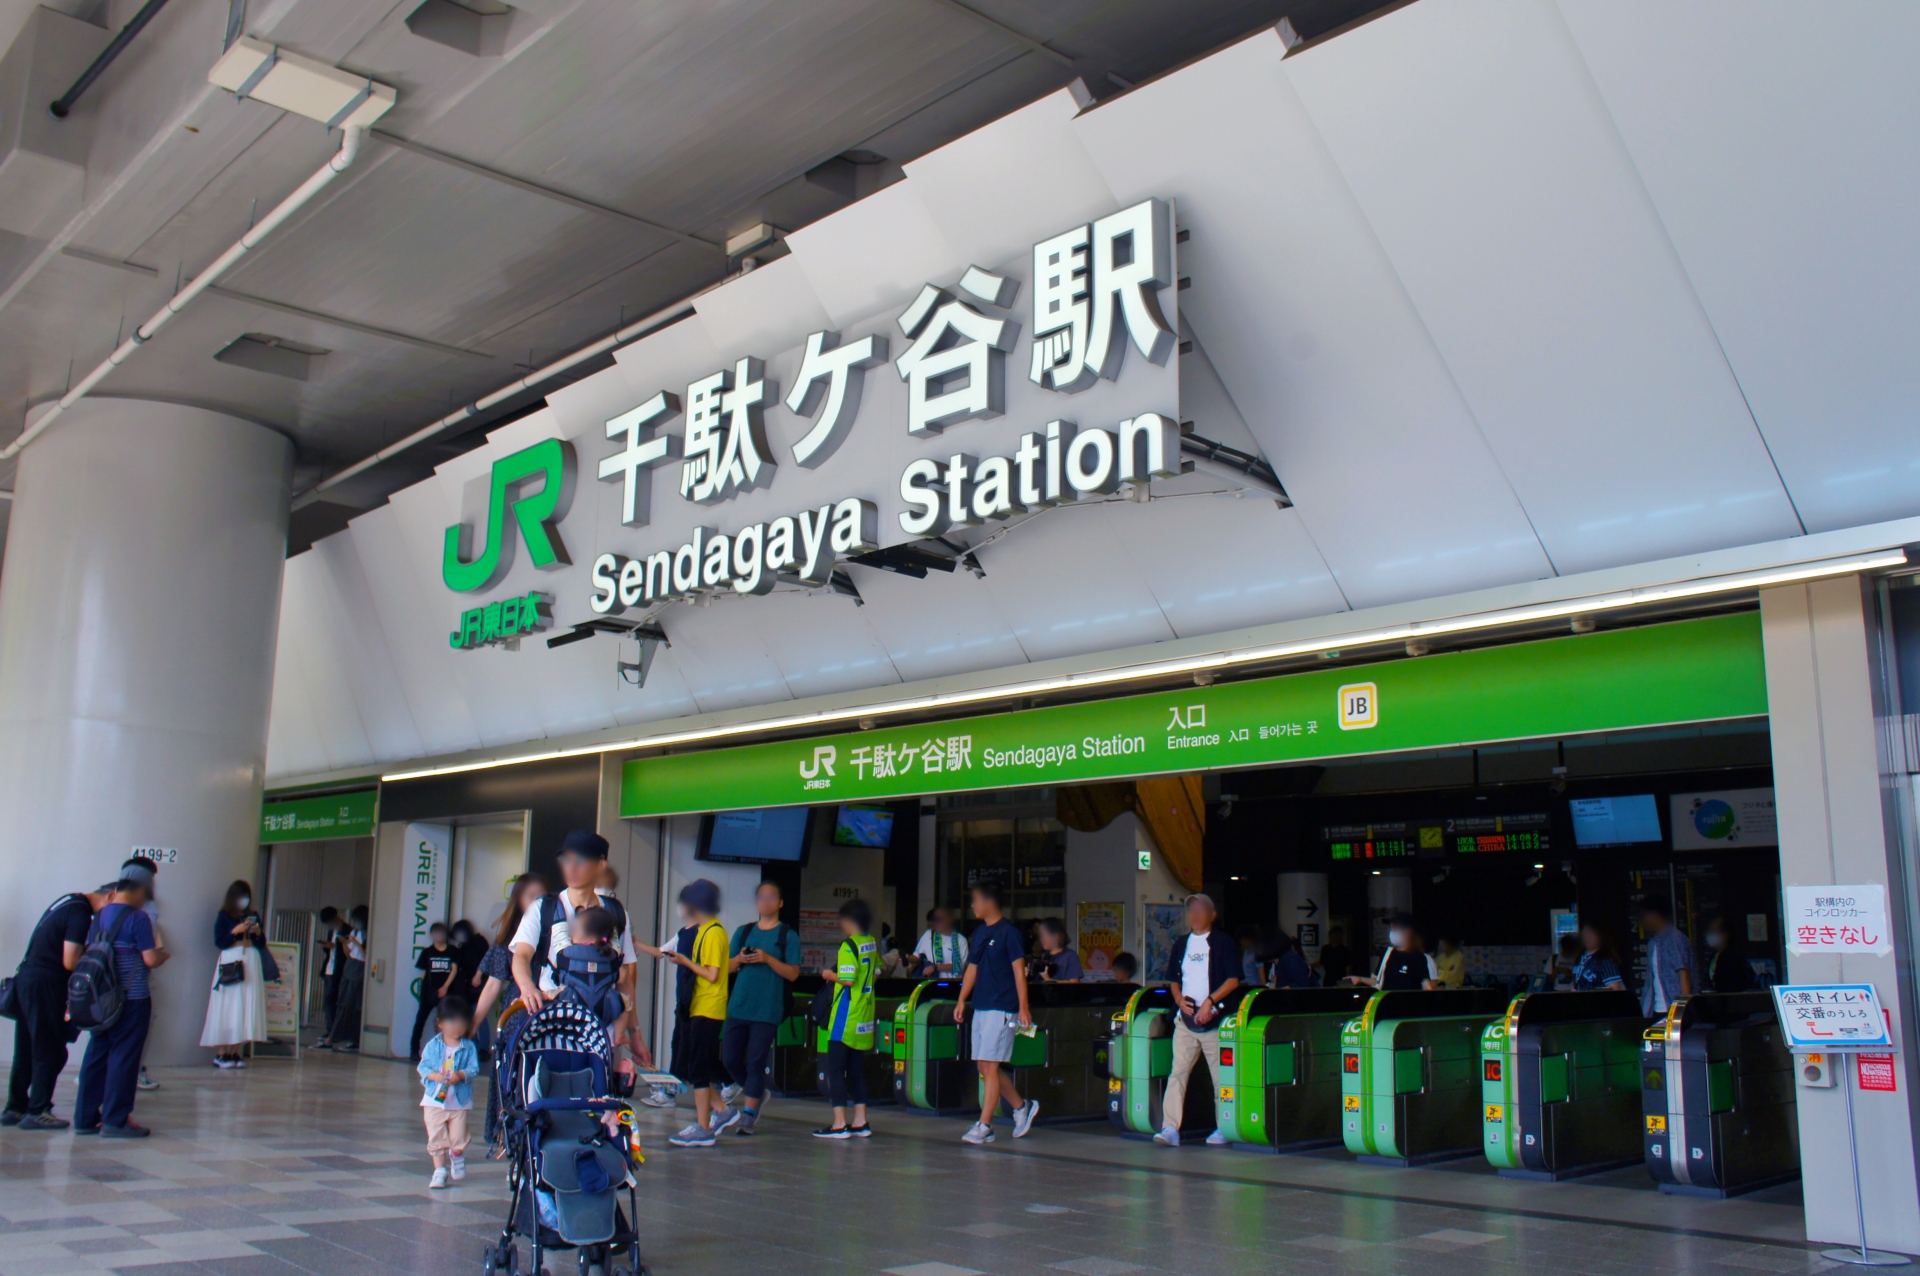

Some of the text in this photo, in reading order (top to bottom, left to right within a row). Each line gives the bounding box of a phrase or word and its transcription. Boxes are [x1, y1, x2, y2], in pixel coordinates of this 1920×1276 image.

[597, 199, 1172, 526] 千駄ケ谷駅
[443, 437, 570, 593] JR
[590, 411, 1173, 614] Sendagaya Station
[450, 592, 545, 648] JR東日本
[1347, 696, 1367, 716] JB
[1166, 704, 1206, 731] 入口
[1228, 729, 1249, 743] 入口
[1258, 720, 1318, 740] 들어가는 곳
[1167, 732, 1220, 750] Entrance
[850, 735, 972, 781] 千駄ケ谷駅
[983, 733, 1146, 770] Sendagaya Station
[799, 745, 836, 779] JR
[803, 779, 831, 791] JR東日本
[1446, 819, 1454, 832] 2
[1477, 843, 1506, 852] CHIBA
[833, 887, 859, 898] 4199-3
[412, 841, 431, 960] JRE MALL
[1815, 897, 1855, 907] 駅構内の
[1804, 908, 1868, 917] コインロッカー
[1797, 925, 1879, 945] 空きなし
[1784, 992, 1856, 1004] 公衆トイレ
[1795, 1006, 1868, 1020] 交番のうしろ
[1221, 1016, 1237, 1028] IC
[1345, 1021, 1362, 1033] IC
[1484, 1025, 1504, 1038] IC
[1344, 1035, 1358, 1044] 専用
[1484, 1041, 1500, 1050] 専用
[1346, 1057, 1358, 1072] IC
[1860, 1062, 1869, 1075] NO
[1487, 1064, 1501, 1080] IC
